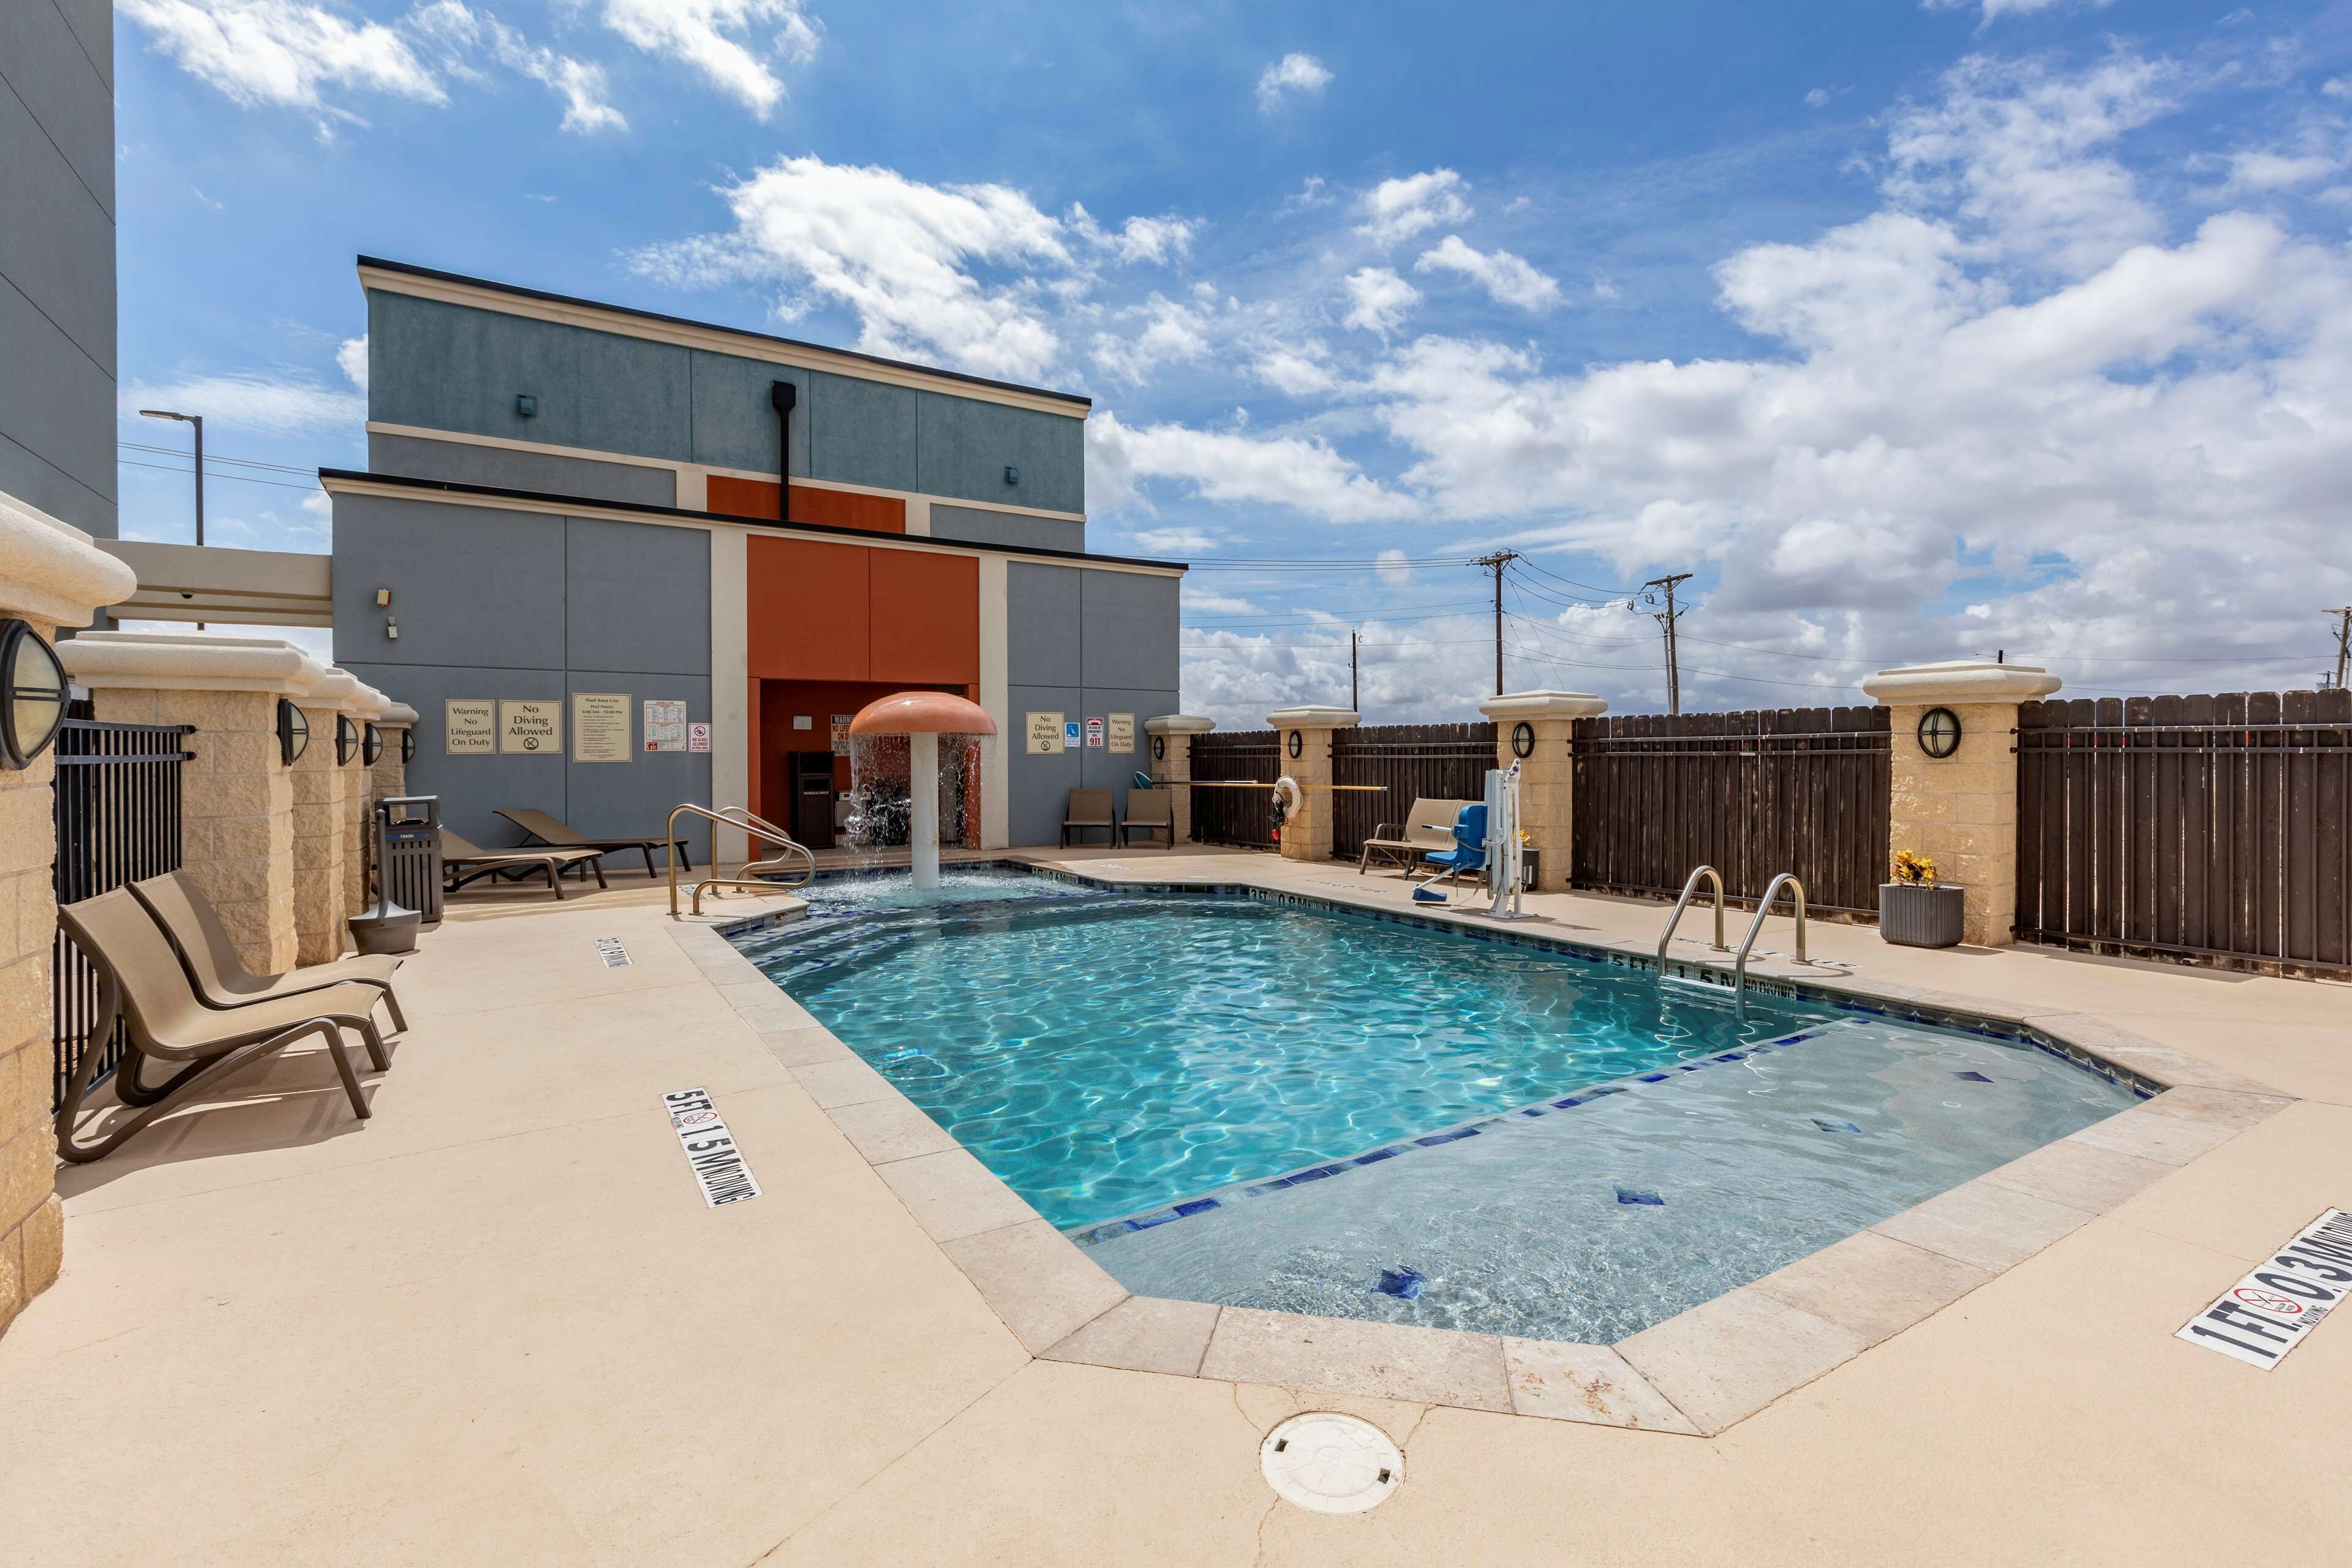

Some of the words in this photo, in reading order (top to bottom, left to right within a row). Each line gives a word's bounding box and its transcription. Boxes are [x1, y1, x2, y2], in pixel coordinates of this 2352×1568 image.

[452, 708, 489, 717] Warning
[523, 705, 539, 714] No
[514, 715, 548, 727] Diving
[451, 728, 491, 737] Lifeguard
[508, 726, 552, 736] Allowed
[1035, 724, 1057, 733] Diving
[469, 739, 491, 747] Duty
[1259, 890, 1268, 900] FT
[1759, 979, 1795, 999] DIVING
[666, 1090, 705, 1101] 5
[691, 1149, 741, 1171] M
[700, 1164, 743, 1180] NO
[705, 1174, 756, 1205] DIVING
[2190, 1325, 2279, 1359] 1
